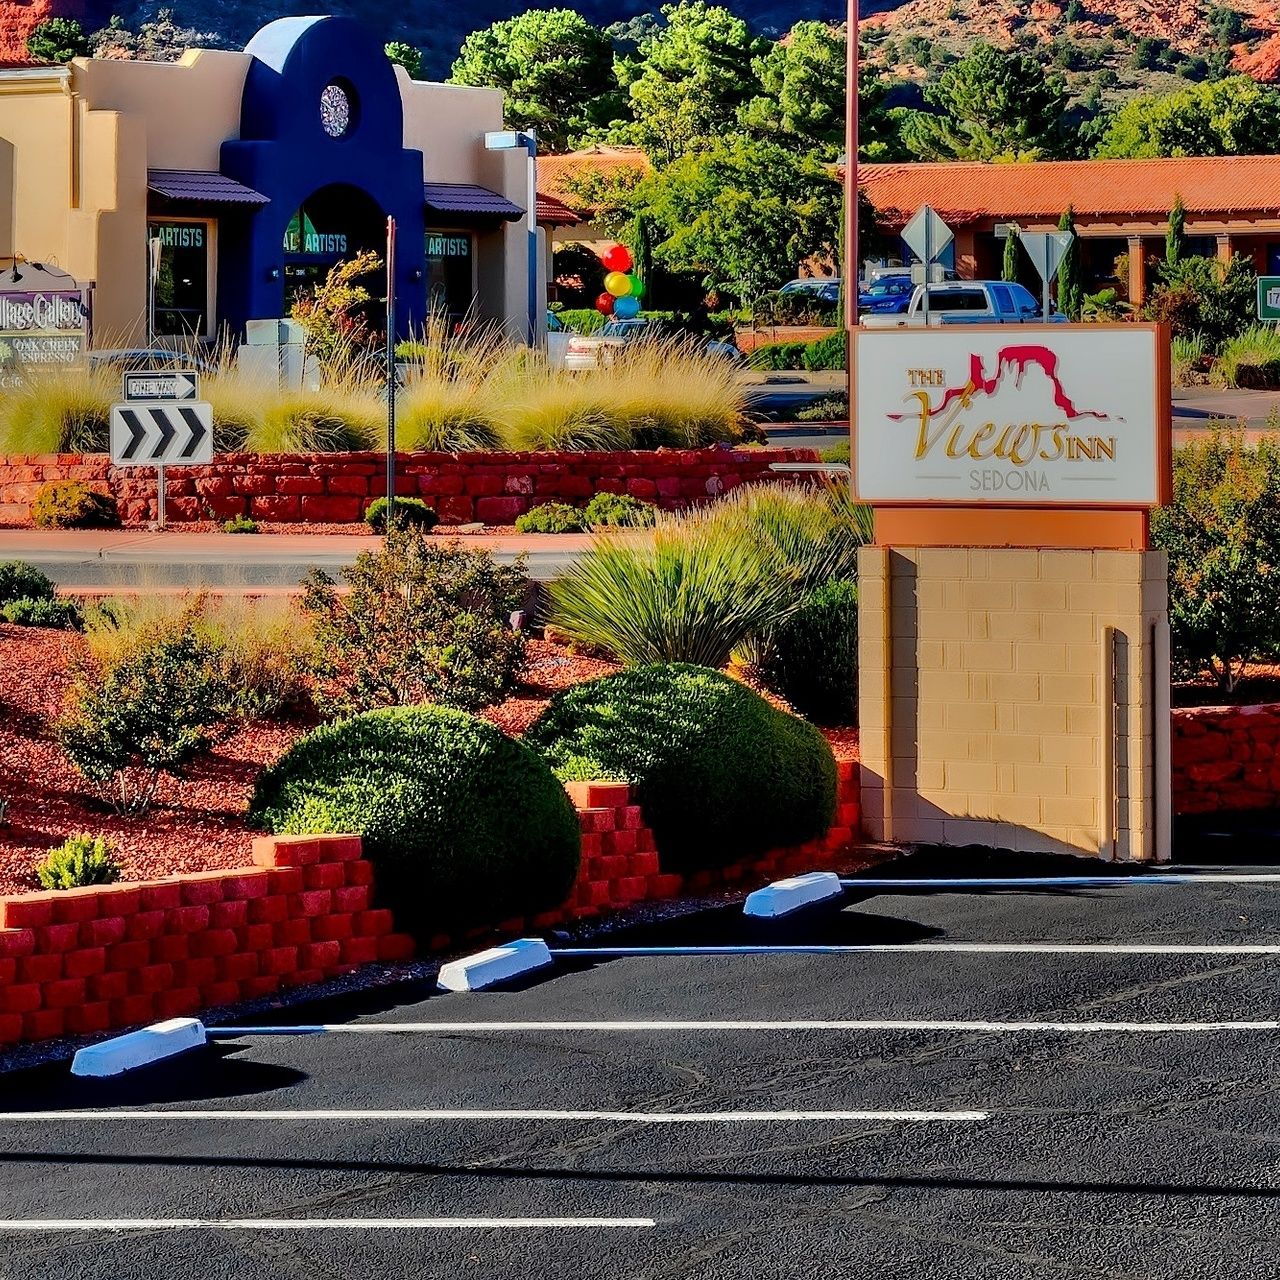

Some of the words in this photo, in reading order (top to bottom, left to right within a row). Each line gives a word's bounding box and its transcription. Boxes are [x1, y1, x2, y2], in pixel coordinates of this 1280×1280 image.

[158, 227, 202, 247] ARTISTS
[304, 233, 347, 252] ARTISTS
[428, 237, 468, 256] ARTISTS
[13, 338, 40, 352] OAK
[42, 337, 80, 352] CREEK
[21, 352, 74, 363] ESPRESSO
[907, 368, 947, 387] THE
[903, 379, 1068, 466] Views
[1065, 434, 1117, 462] INN
[969, 469, 1050, 492] SEDONA
